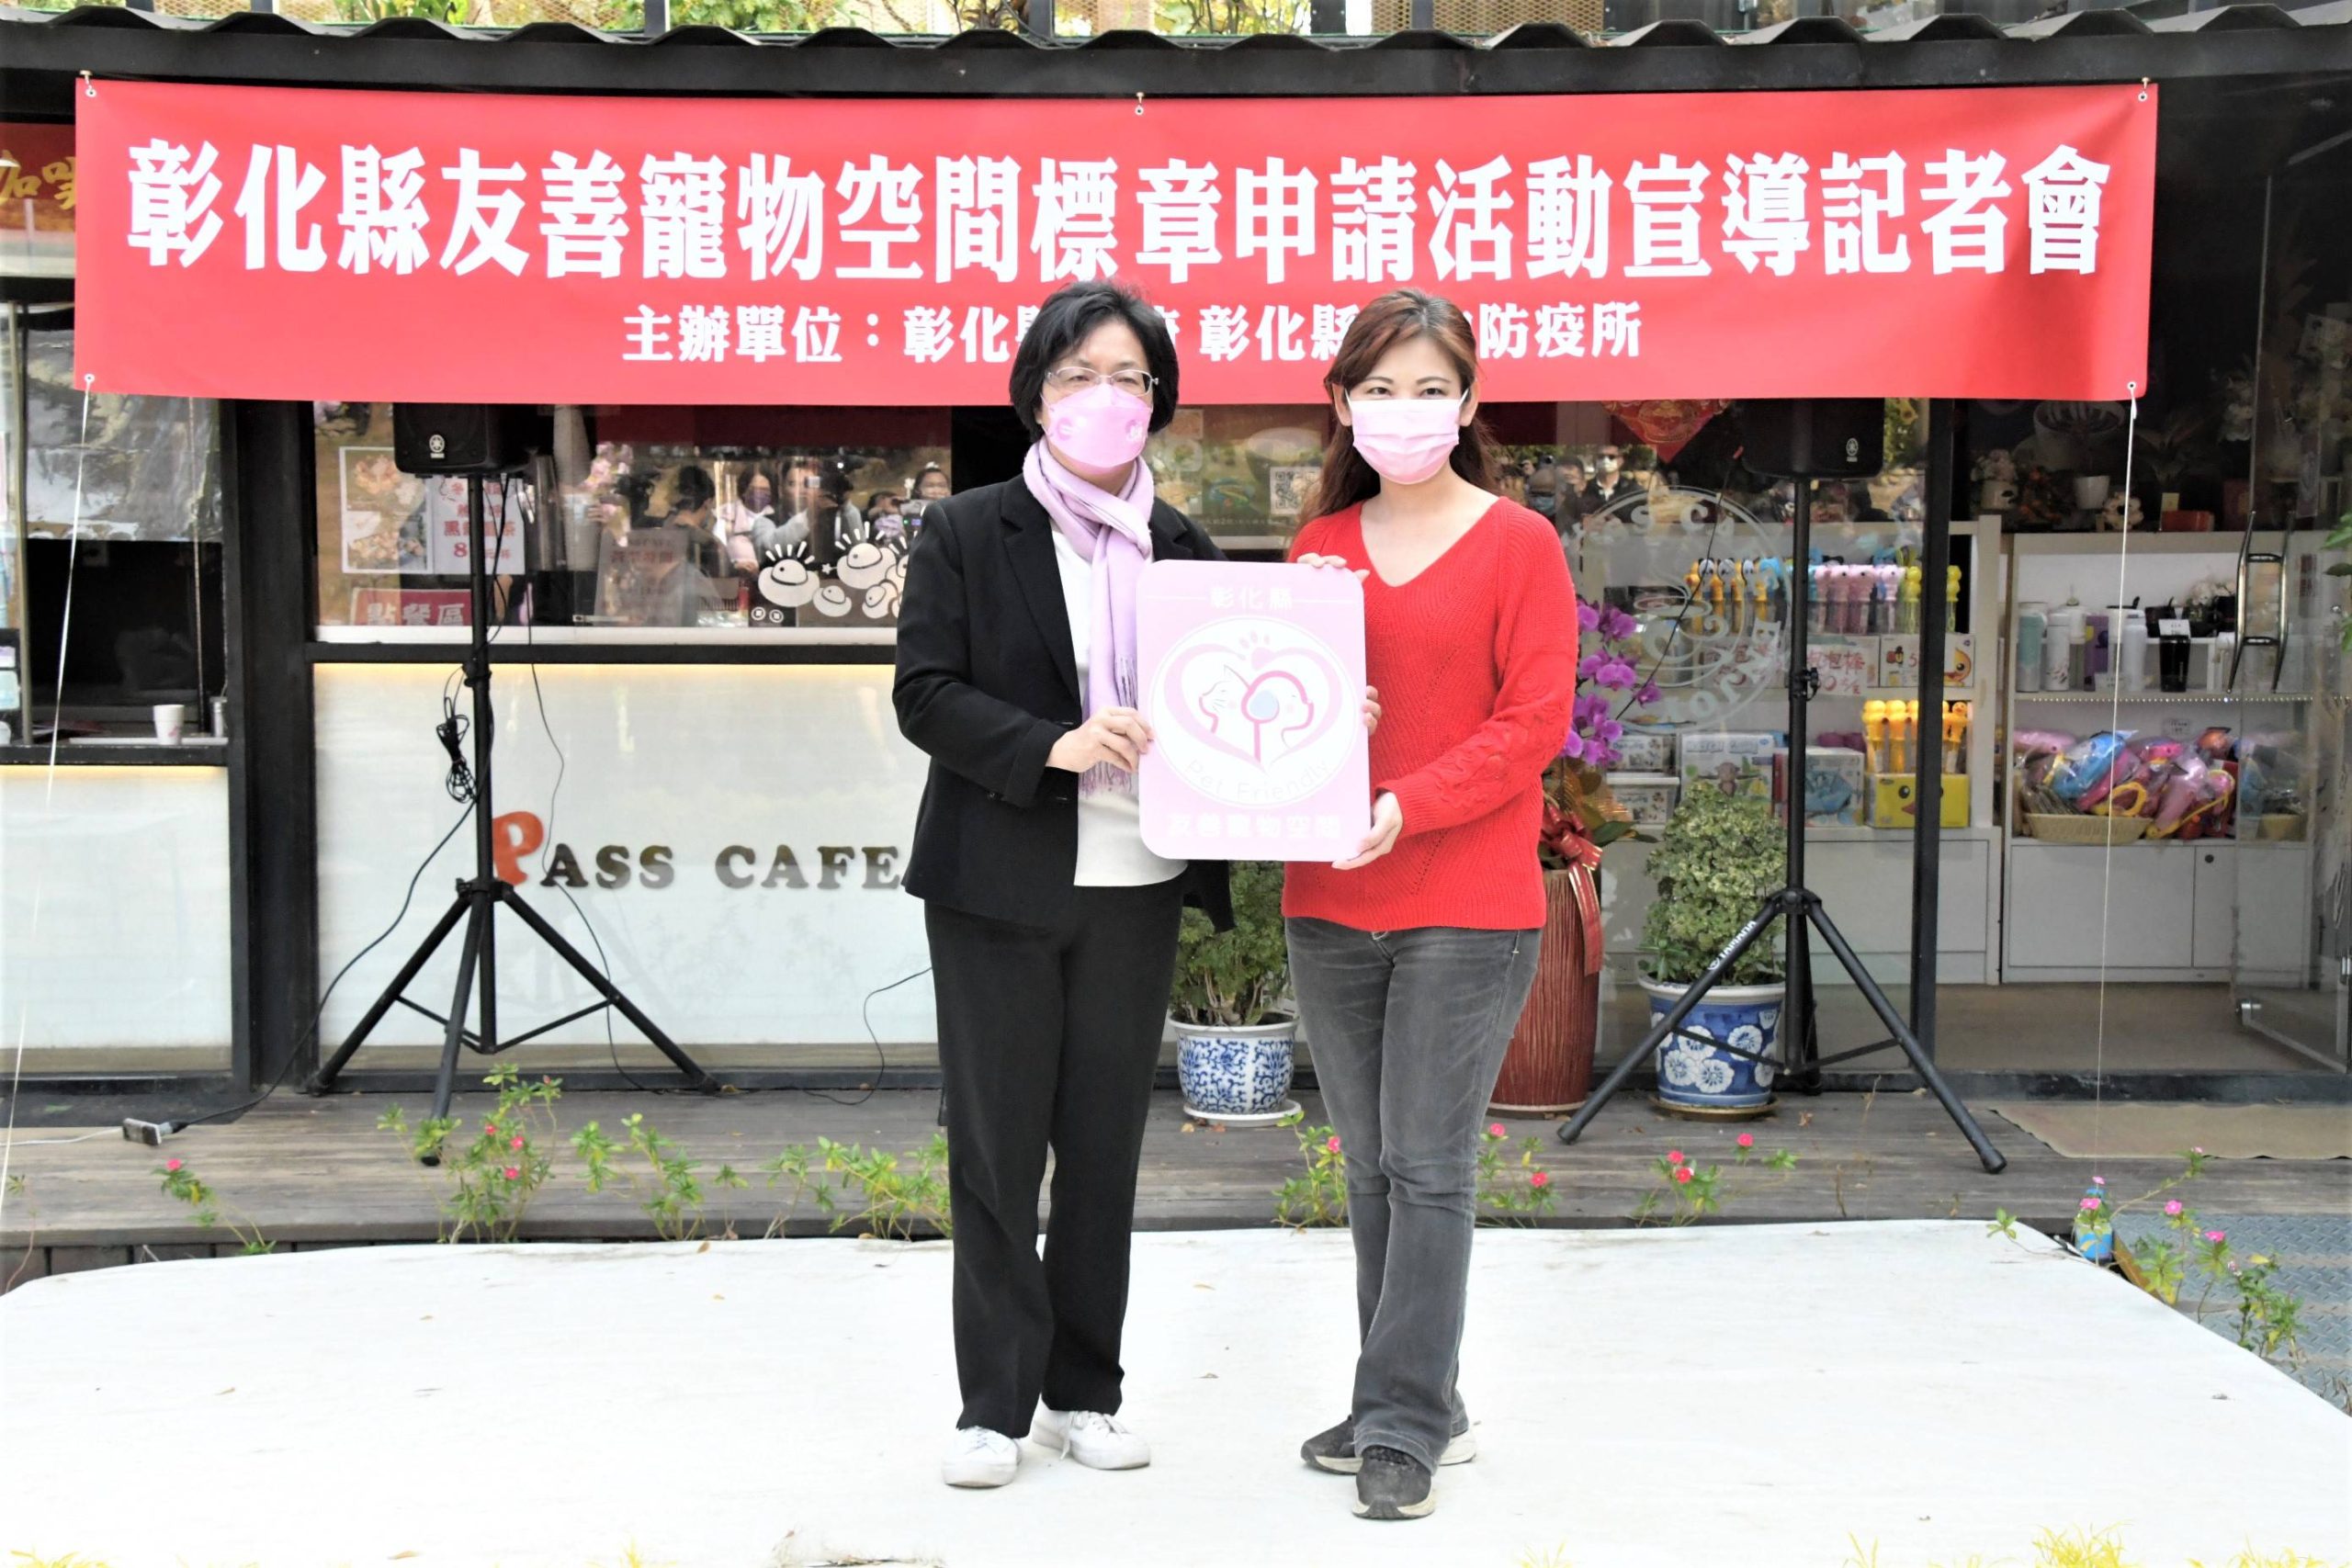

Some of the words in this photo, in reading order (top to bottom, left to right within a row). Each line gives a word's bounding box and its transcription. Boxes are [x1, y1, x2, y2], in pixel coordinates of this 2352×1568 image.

[128, 139, 2111, 283] 彰化縣友善寵物空間標章申請活動宣導記者會
[1198, 301, 1642, 364] 彰化縣防疫所
[1209, 587, 1293, 610] 彰化縣
[1185, 759, 1225, 792] Pet
[1237, 759, 1331, 801] Friendly
[492, 811, 676, 889] PASS
[715, 844, 901, 889] CAFE
